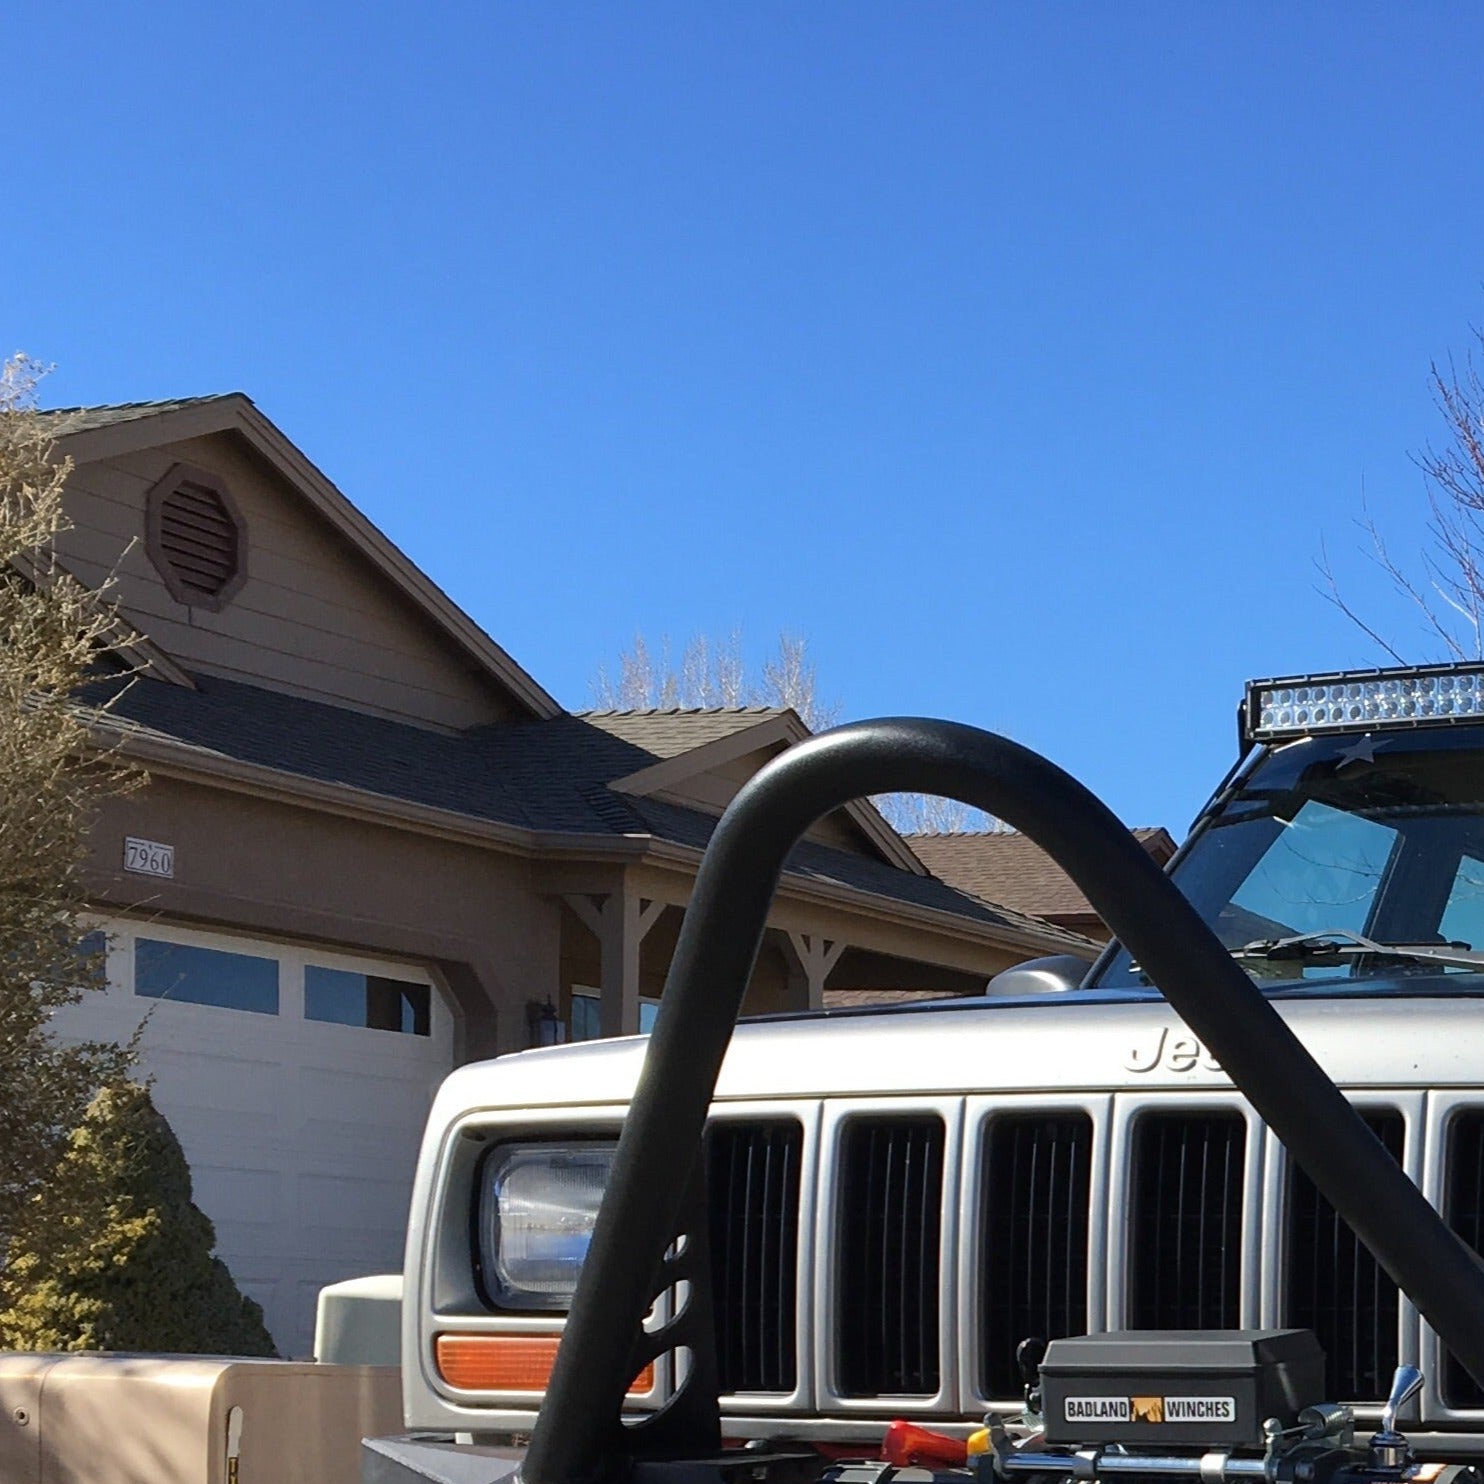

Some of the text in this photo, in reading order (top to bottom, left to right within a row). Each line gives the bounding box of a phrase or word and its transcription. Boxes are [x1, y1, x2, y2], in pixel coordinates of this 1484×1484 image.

[128, 846, 170, 873] 7960
[1125, 1027, 1225, 1074] Je
[1067, 1400, 1230, 1418] BADLAND WINCHES
